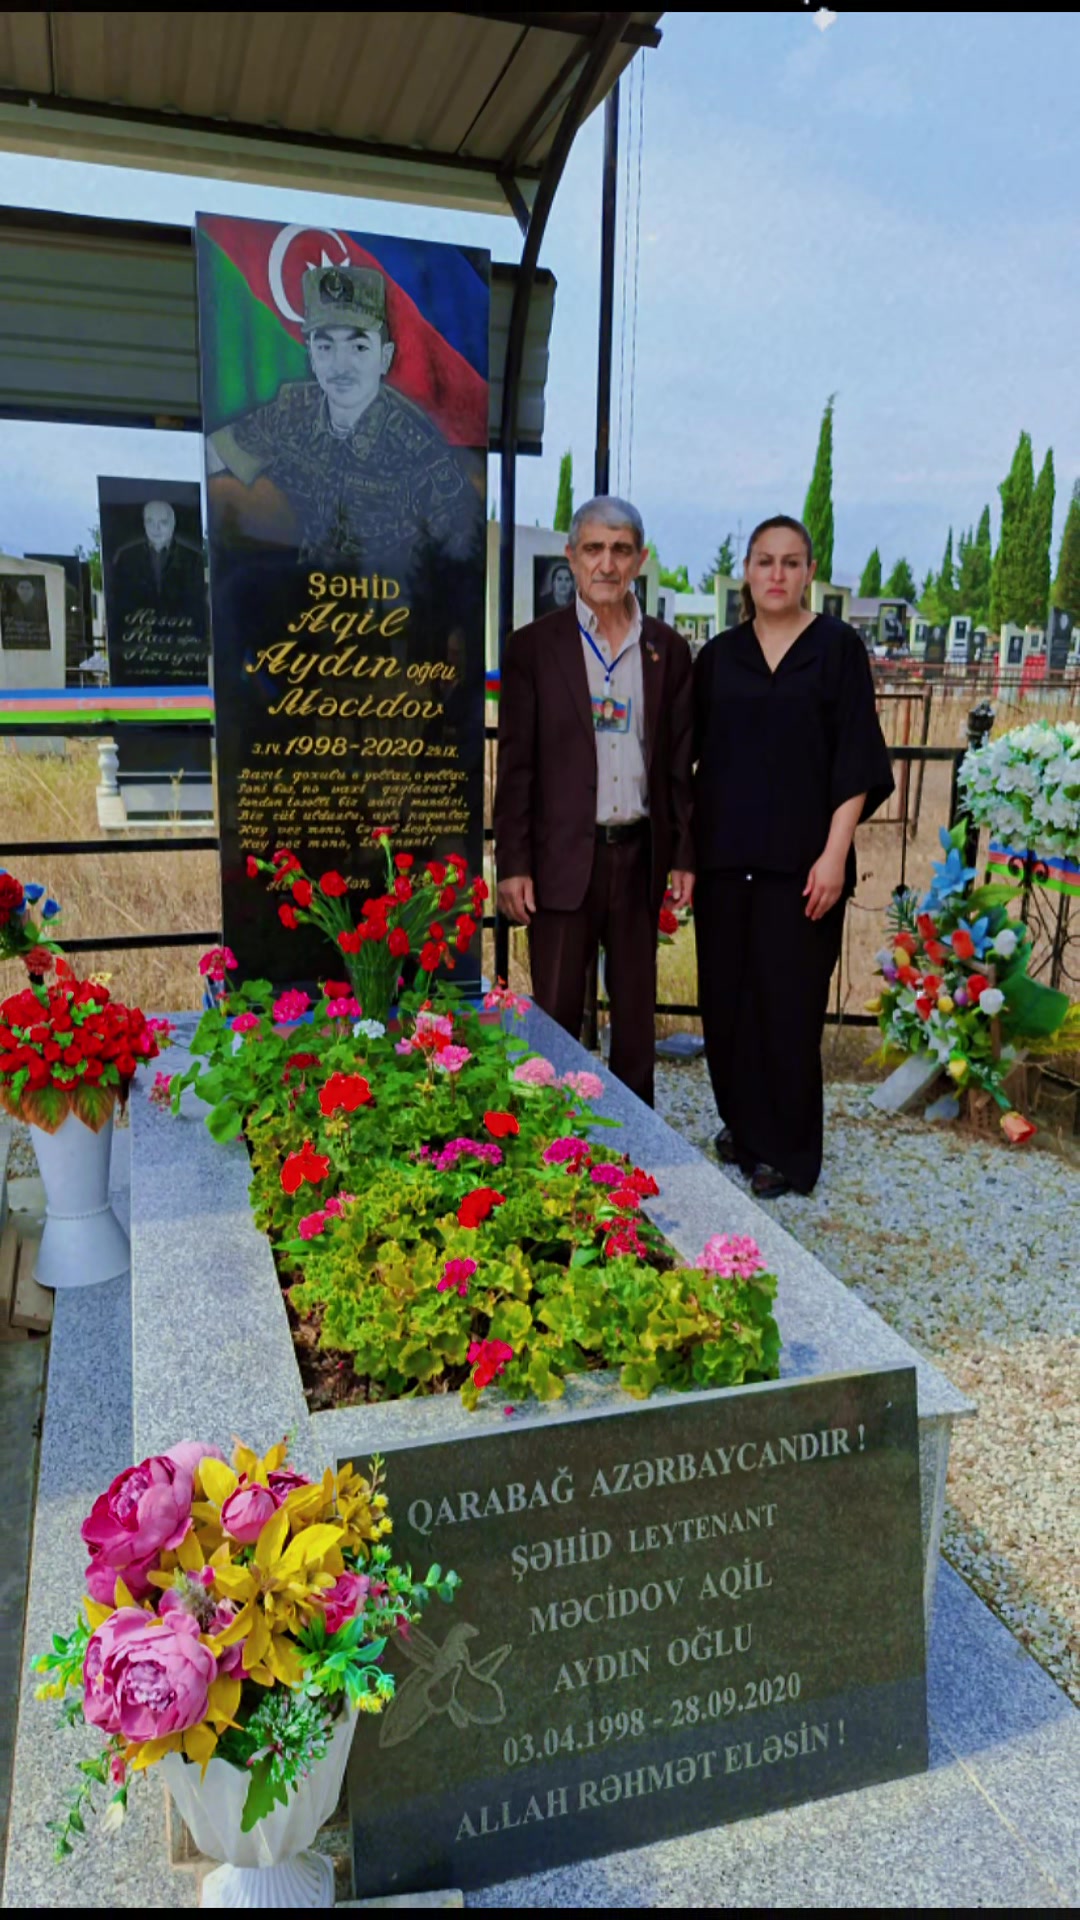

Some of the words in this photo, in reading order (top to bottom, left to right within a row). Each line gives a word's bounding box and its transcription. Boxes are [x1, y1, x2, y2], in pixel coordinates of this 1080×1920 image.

[308, 572, 400, 599] ŞƏHİD
[287, 601, 410, 644] Aqil
[245, 641, 402, 684] Aydın
[406, 662, 456, 685] oğlu
[267, 687, 444, 720] Məcidov
[407, 1465, 576, 1536] QARABAĞ
[511, 1525, 613, 1584] ŞƏHİD
[628, 1502, 778, 1552] LEYTENANT
[529, 1576, 684, 1636] MƏCİDOV
[699, 1557, 773, 1600] AQİL
[553, 1645, 650, 1693] AYDIN
[667, 1623, 753, 1667] OĞLU
[503, 1708, 646, 1766] 03.04.1998
[671, 1671, 801, 1728] 28.09.2020
[455, 1786, 569, 1841] ALLAH
[578, 1750, 718, 1811] RƏHMƏT
